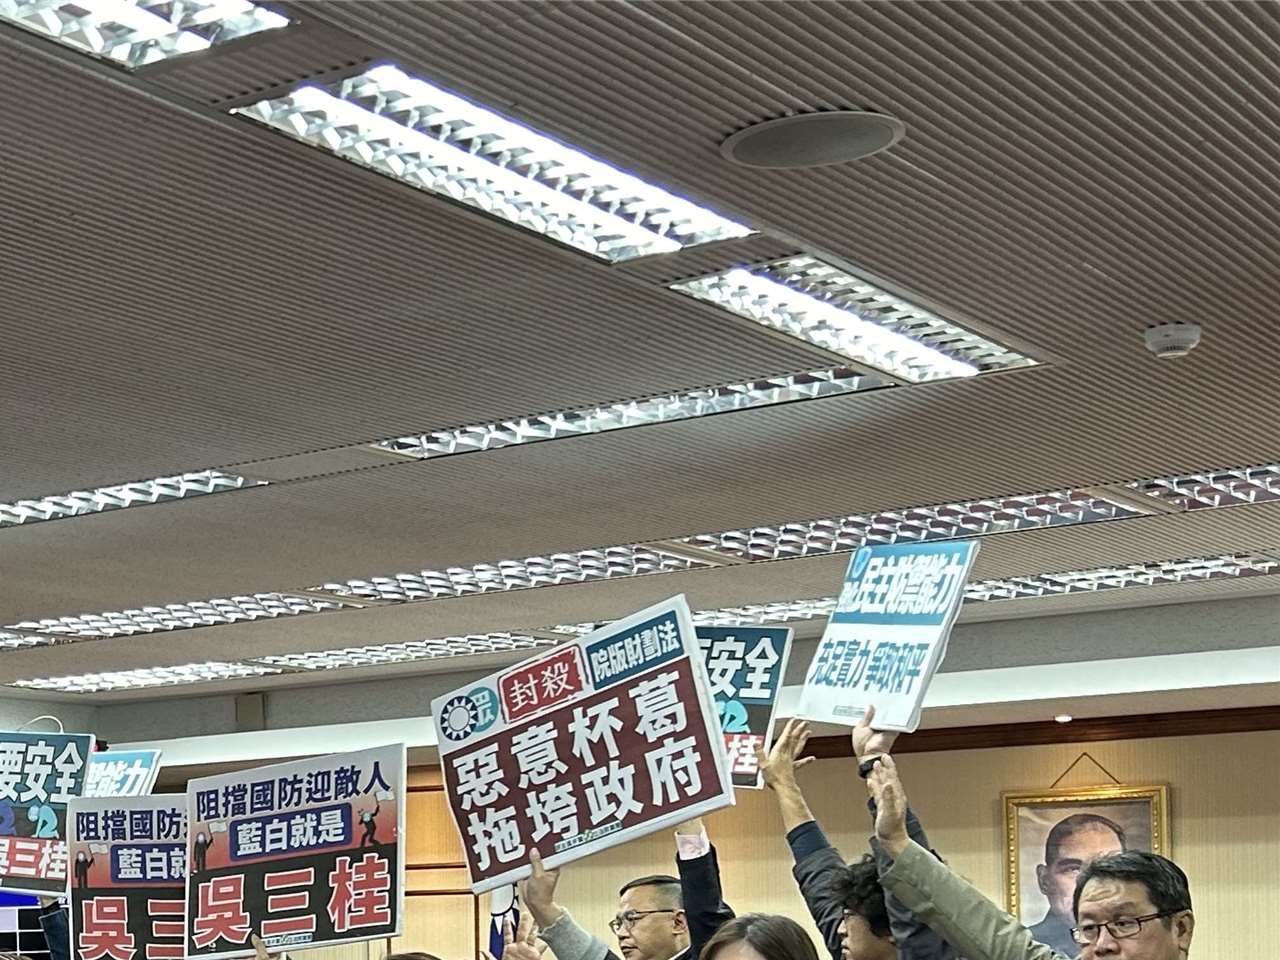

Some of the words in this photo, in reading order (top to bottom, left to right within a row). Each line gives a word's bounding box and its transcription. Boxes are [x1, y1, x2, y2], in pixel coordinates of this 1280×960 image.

[592, 619, 680, 682] 院版財劃法
[699, 636, 780, 699] 安全
[509, 661, 576, 713] 封殺
[452, 669, 688, 810] 惡意杯葛
[196, 760, 393, 822] 阻擋國防迎敵人
[467, 736, 702, 872] 拖垮政府
[76, 808, 187, 842] 阻擋國防
[236, 810, 346, 857] 藍白就是
[193, 853, 392, 948] 吳三桂
